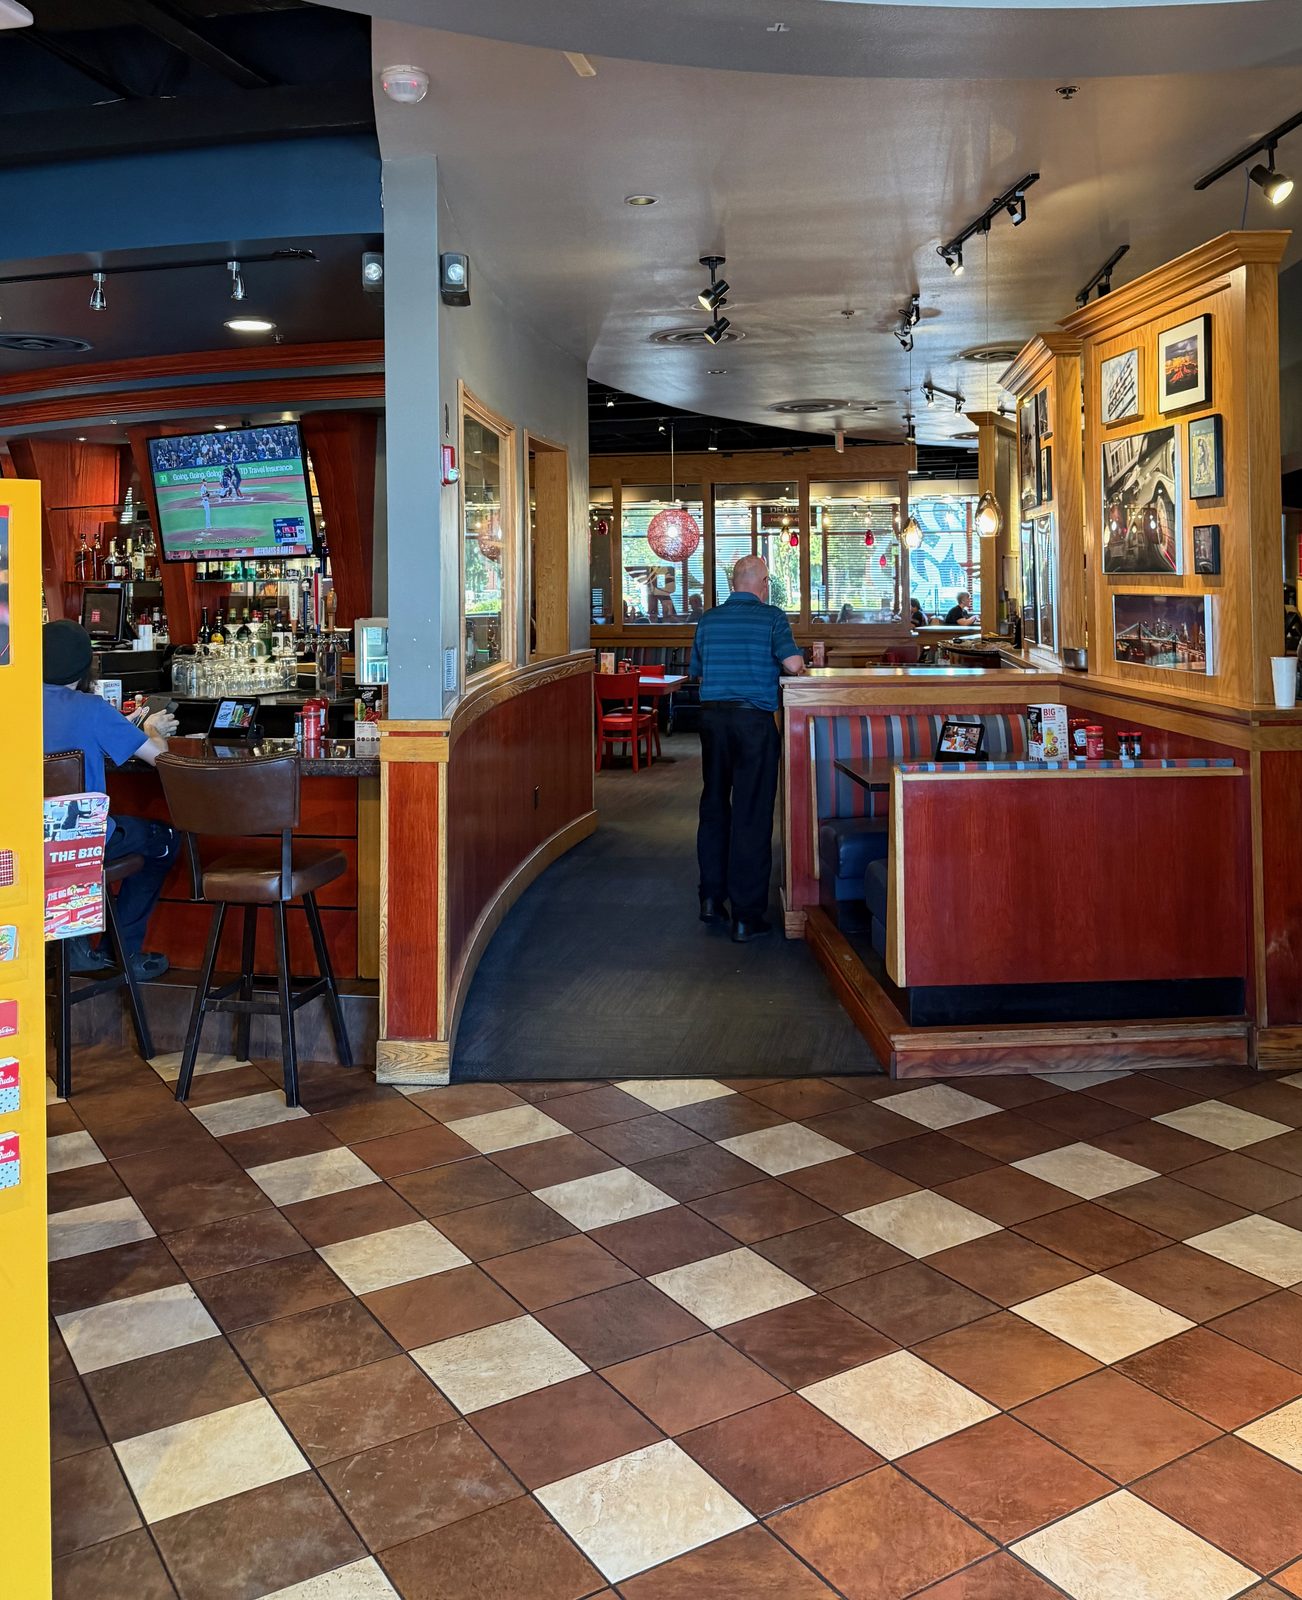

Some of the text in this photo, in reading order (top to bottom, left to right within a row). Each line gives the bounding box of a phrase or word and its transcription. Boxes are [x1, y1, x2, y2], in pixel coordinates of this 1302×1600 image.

[249, 466, 265, 474] Travel
[265, 464, 294, 473] Insurance
[172, 473, 189, 481] Going,
[189, 472, 206, 480] Going,
[1043, 708, 1056, 716] BIG
[49, 846, 103, 863] THE BIG
